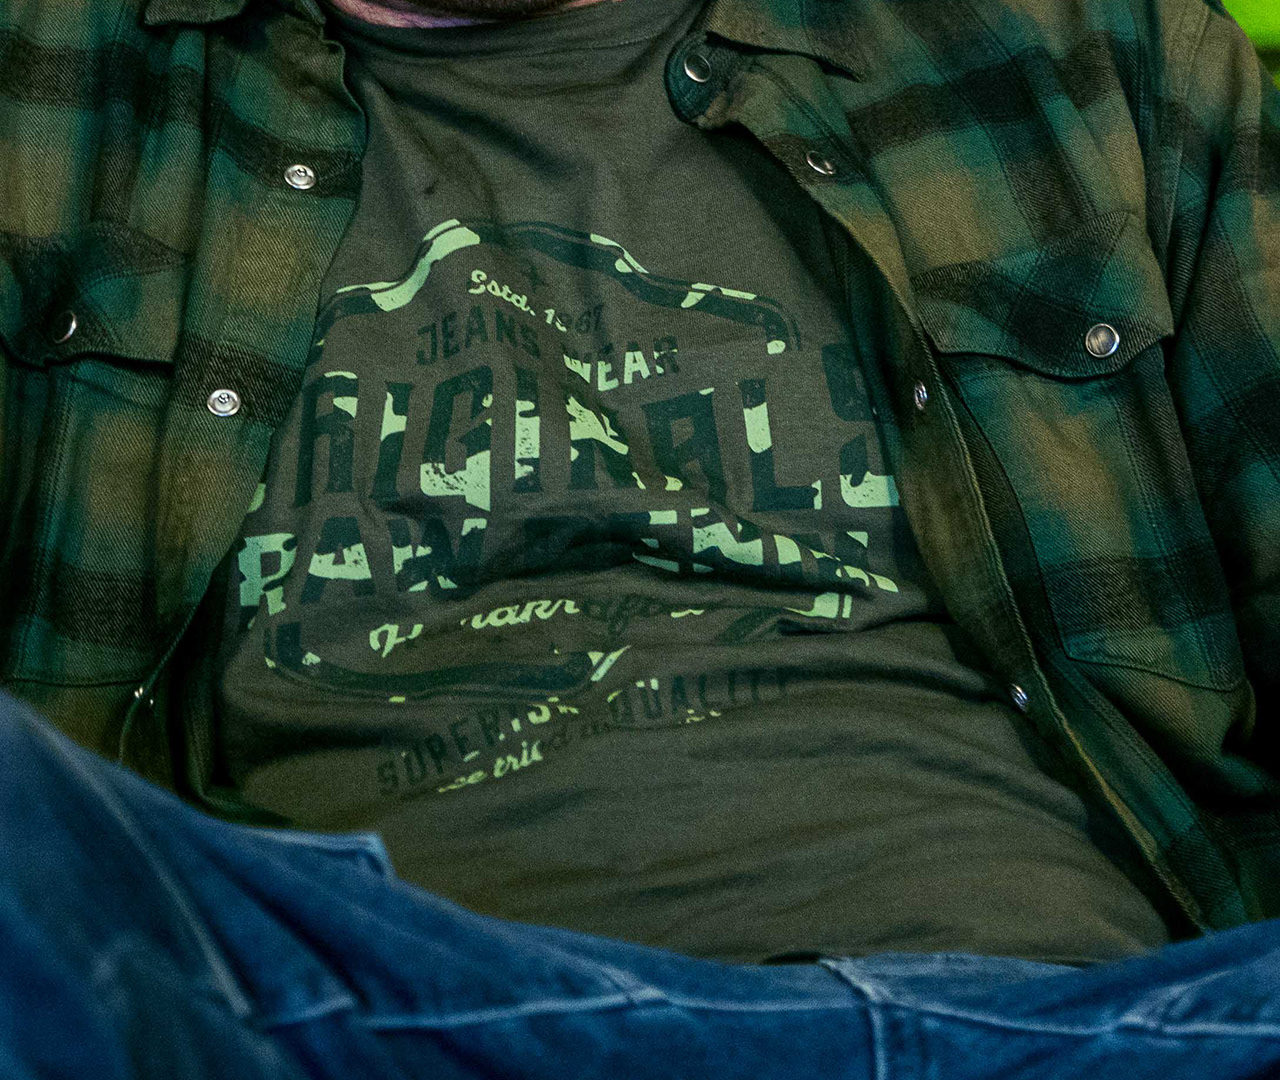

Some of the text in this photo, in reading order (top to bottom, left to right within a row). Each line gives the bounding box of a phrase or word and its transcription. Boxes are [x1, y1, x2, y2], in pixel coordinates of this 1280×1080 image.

[416, 303, 680, 392] JEANS WEAR
[246, 341, 904, 514] RIGINALS
